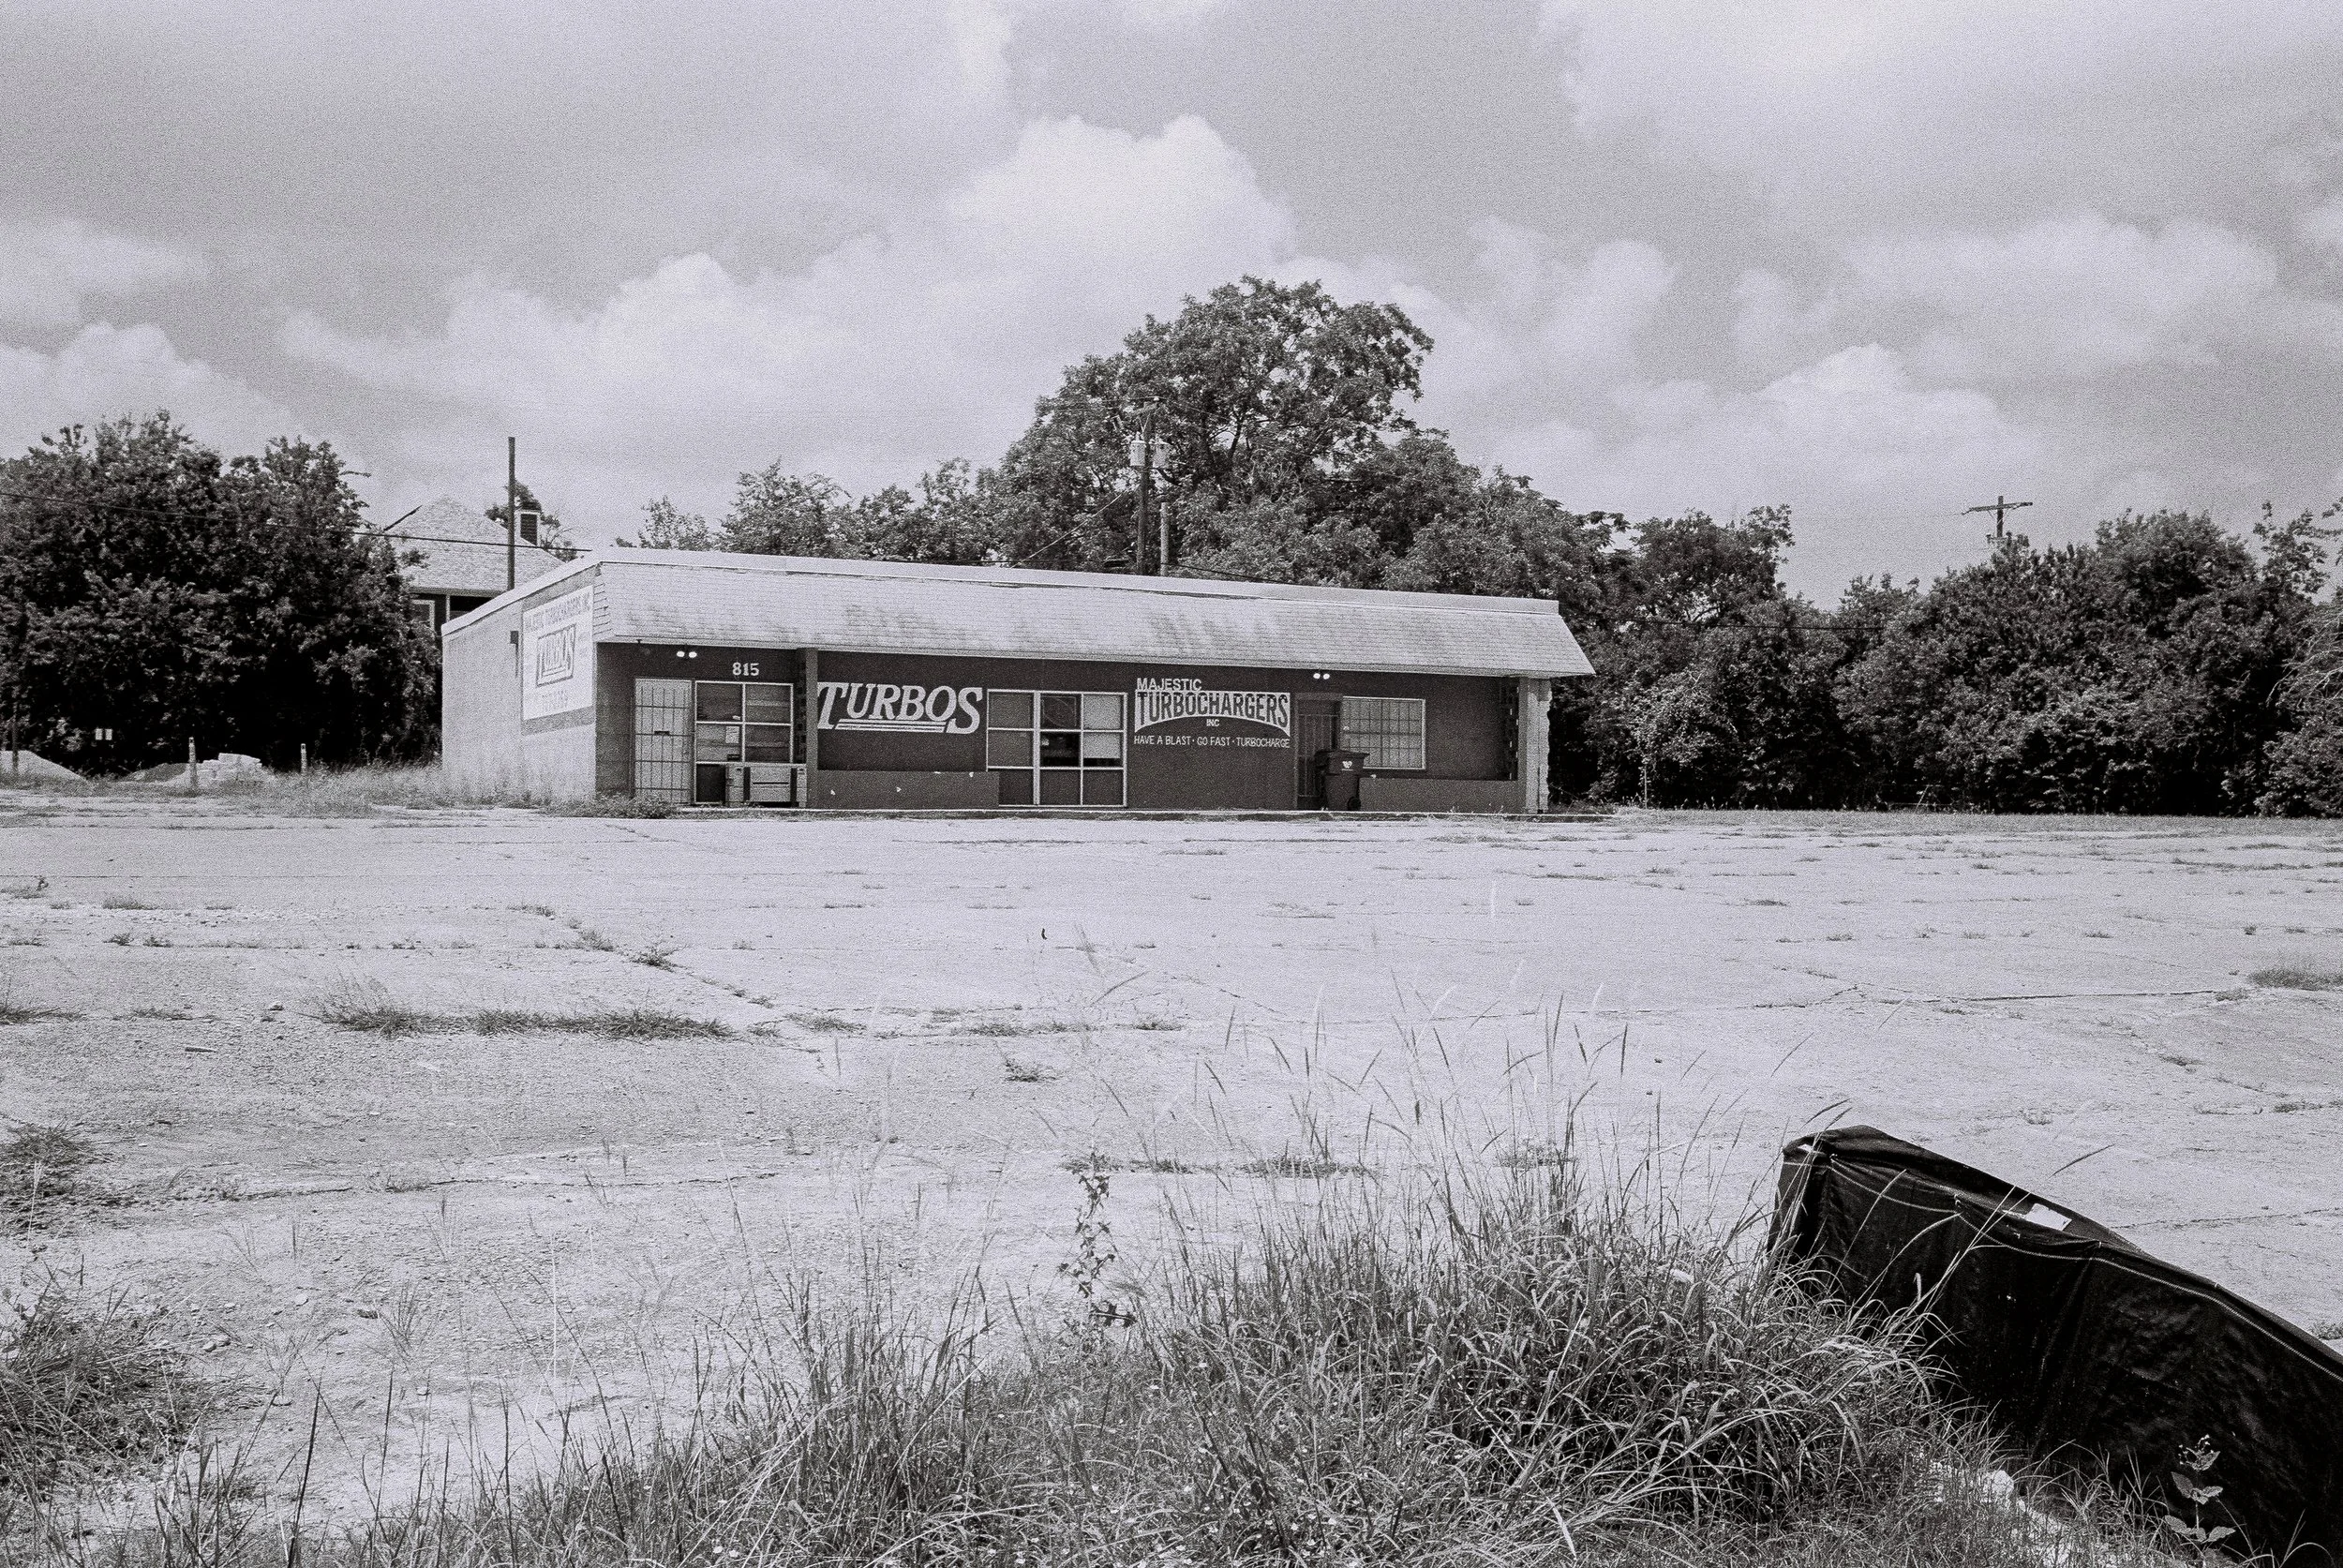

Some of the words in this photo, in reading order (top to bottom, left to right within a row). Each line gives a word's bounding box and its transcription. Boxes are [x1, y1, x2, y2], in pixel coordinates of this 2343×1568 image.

[732, 662, 760, 677] 815
[1137, 678, 1202, 691] MAJESTIC
[817, 681, 983, 735] TURBOS
[1137, 691, 1289, 728] TURBOCHARGERS
[1206, 719, 1219, 727] INC
[1134, 735, 1155, 745] HAVE
[1157, 737, 1163, 745] A
[1166, 736, 1191, 746] BLAST
[1197, 737, 1208, 746] GO
[1210, 737, 1231, 747] FAST
[1236, 738, 1291, 748] TURBOCHARGE
